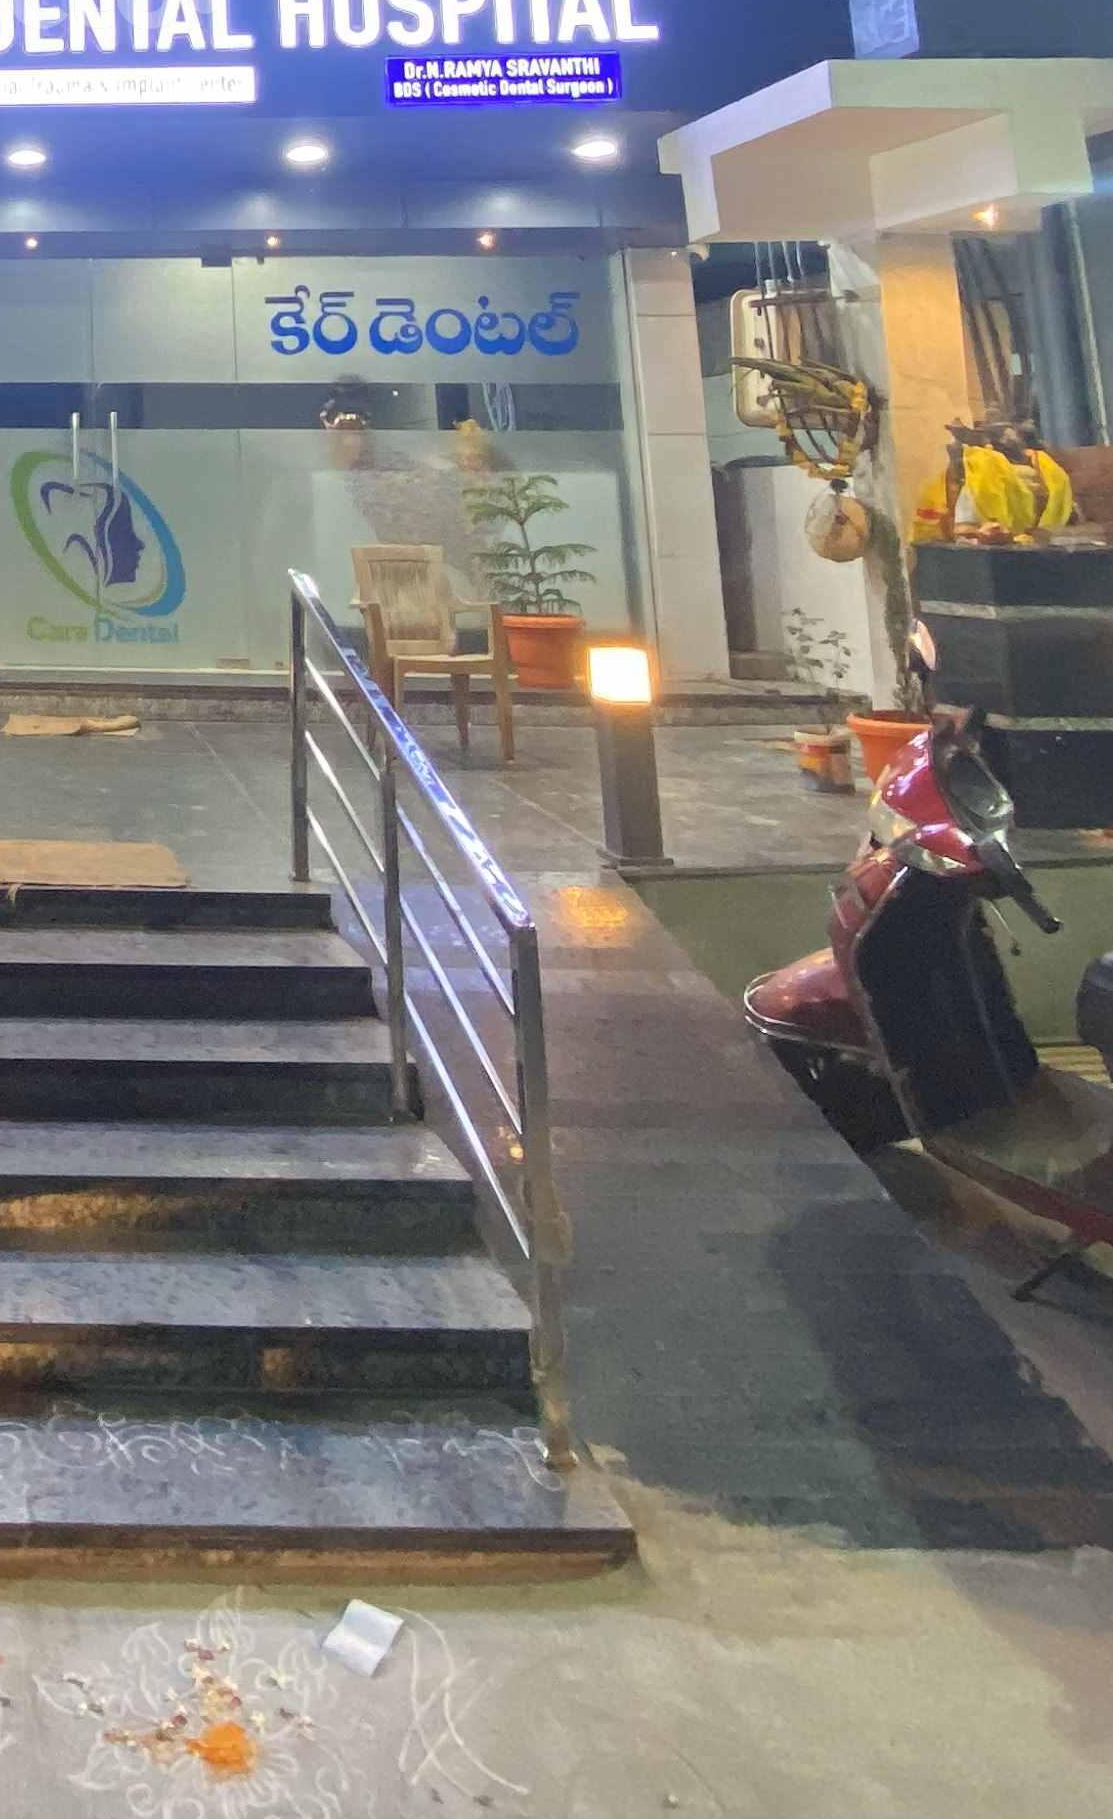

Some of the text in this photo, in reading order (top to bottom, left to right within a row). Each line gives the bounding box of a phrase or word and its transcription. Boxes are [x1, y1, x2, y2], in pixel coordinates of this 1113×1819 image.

[506, 57, 601, 77] SRAVANTHI
[393, 82, 422, 98] BDS
[499, 78, 544, 96] Dental
[264, 285, 581, 357] కేర్ డెంటల్
